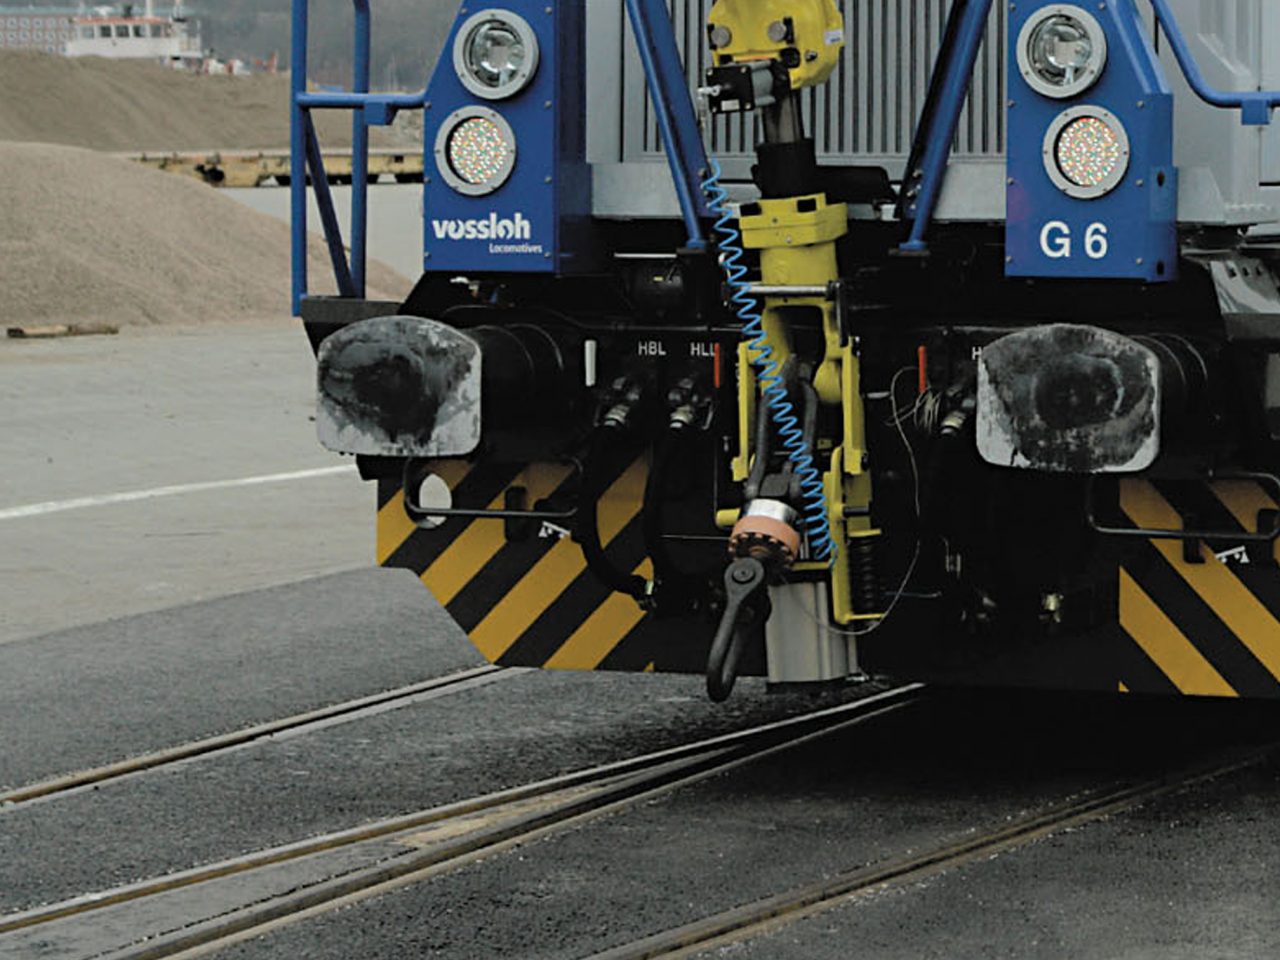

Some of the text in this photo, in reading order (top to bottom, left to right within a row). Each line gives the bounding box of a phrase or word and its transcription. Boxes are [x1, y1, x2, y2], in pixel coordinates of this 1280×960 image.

[432, 212, 531, 240] vossloh
[488, 243, 543, 254] Locomotives
[1040, 220, 1108, 260] G 6
[637, 341, 667, 356] HBL
